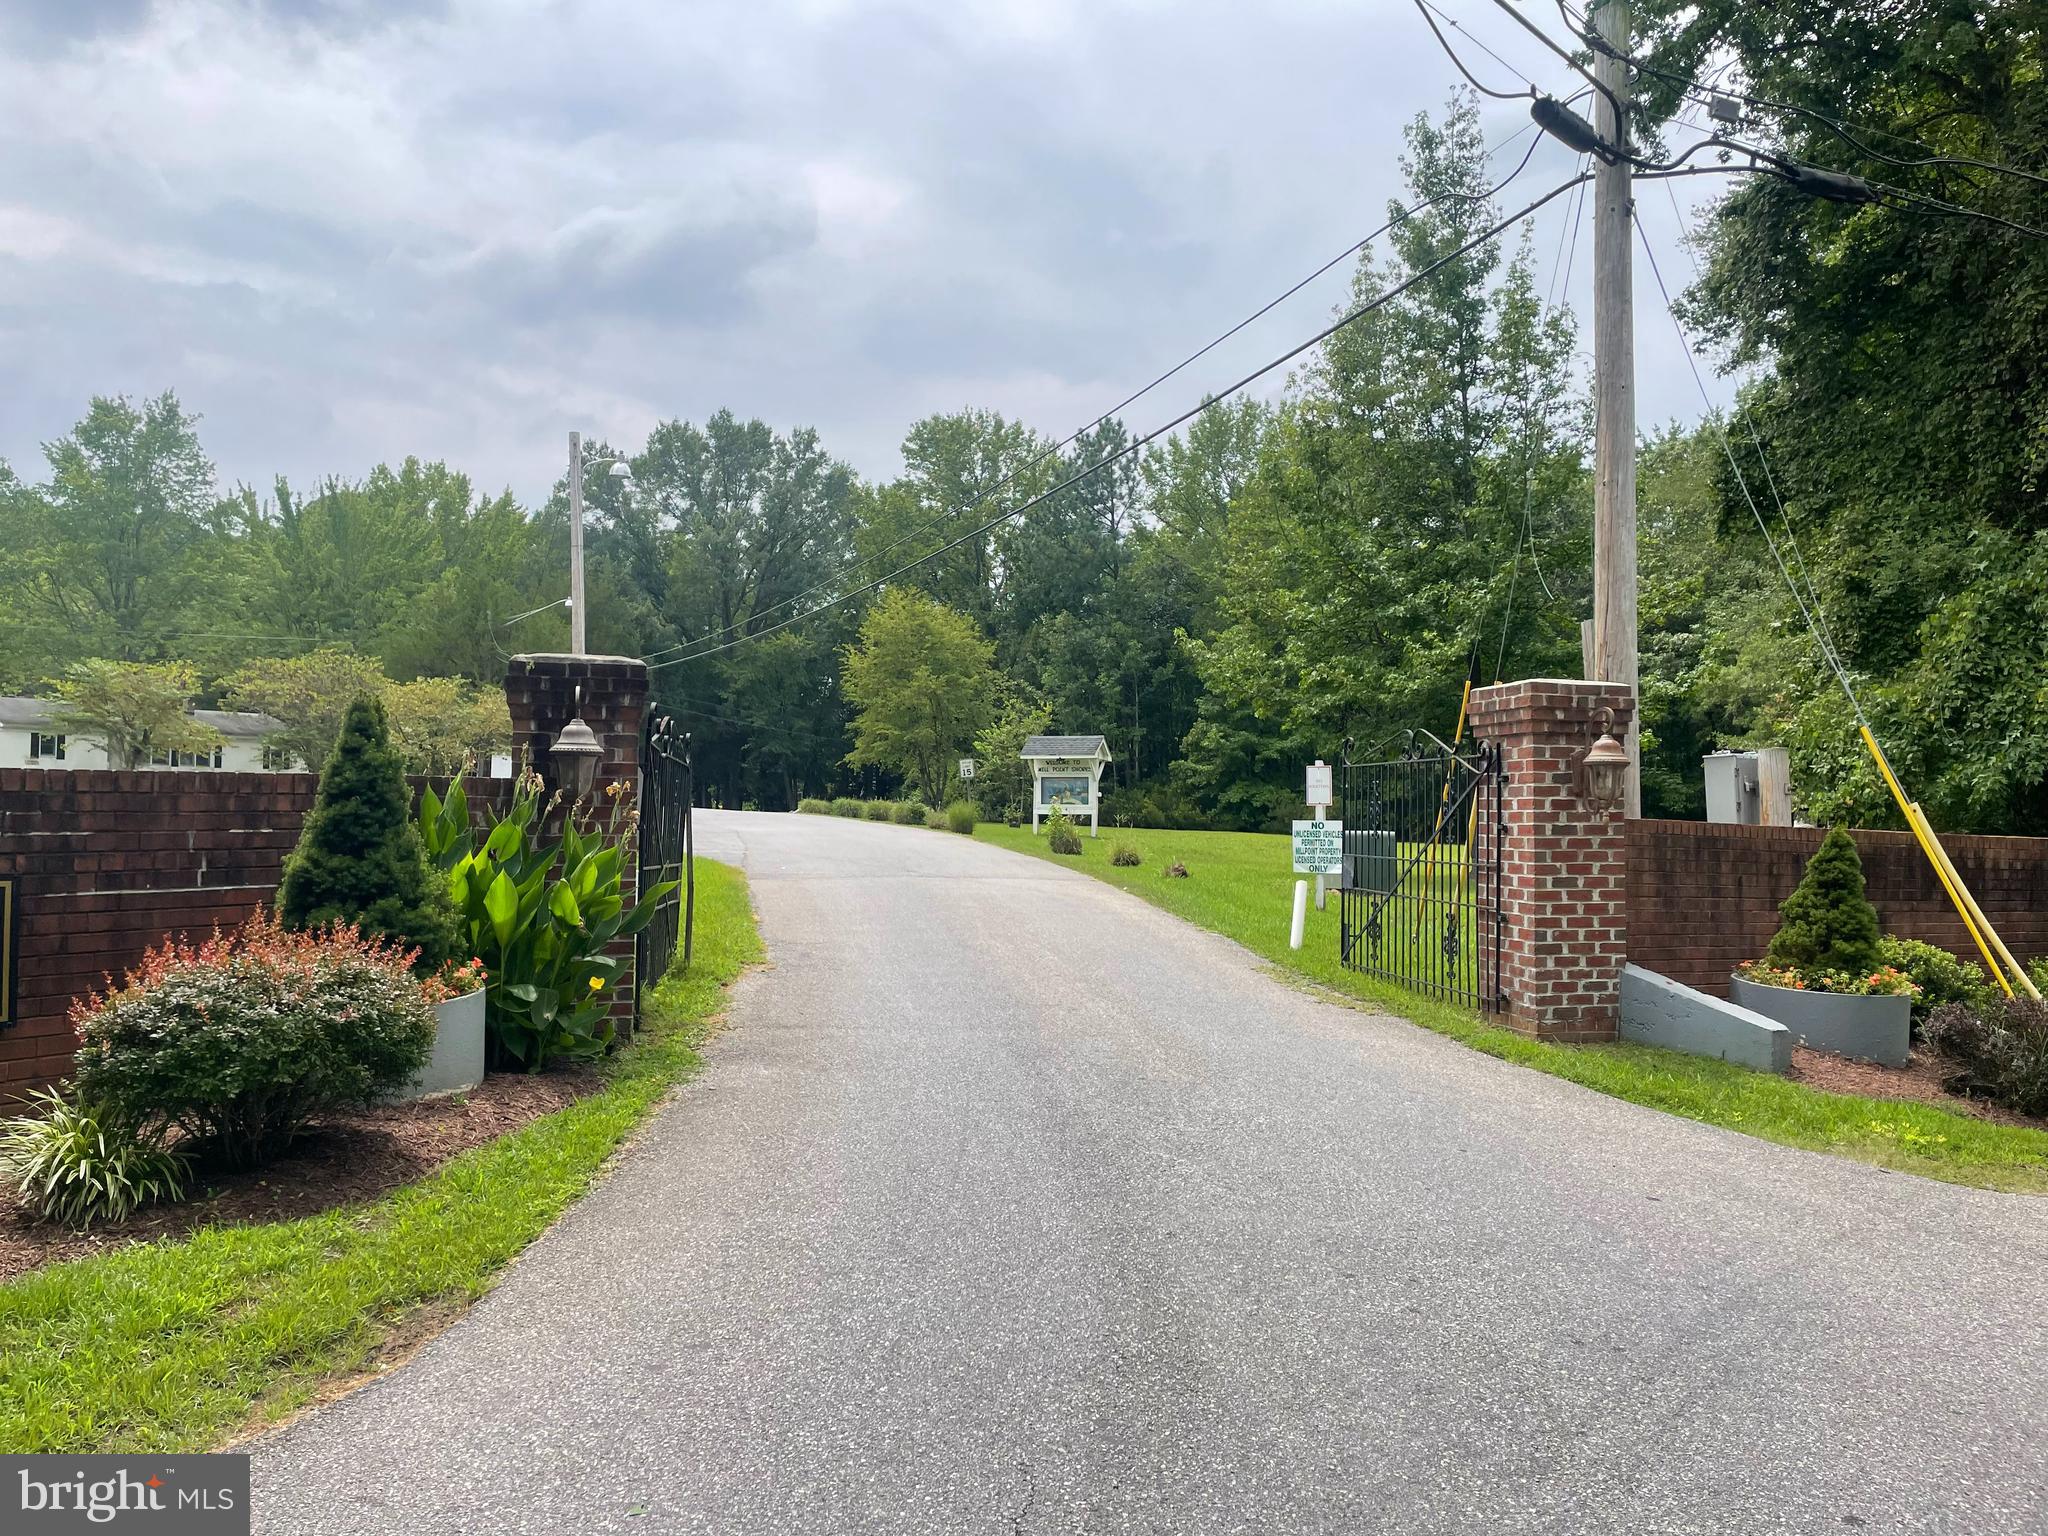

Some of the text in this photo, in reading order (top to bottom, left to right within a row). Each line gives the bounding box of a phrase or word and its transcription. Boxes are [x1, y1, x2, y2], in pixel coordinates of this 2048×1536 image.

[962, 768, 972, 776] 15
[1294, 830, 1344, 838] UNLICENSED VEHICLES
[1327, 839, 1334, 847] ON
[1295, 847, 1341, 855] MILLPOINT PROPERTY
[1295, 855, 1343, 864] LICENSED OPERATORS
[1309, 865, 1328, 873] ONLY
